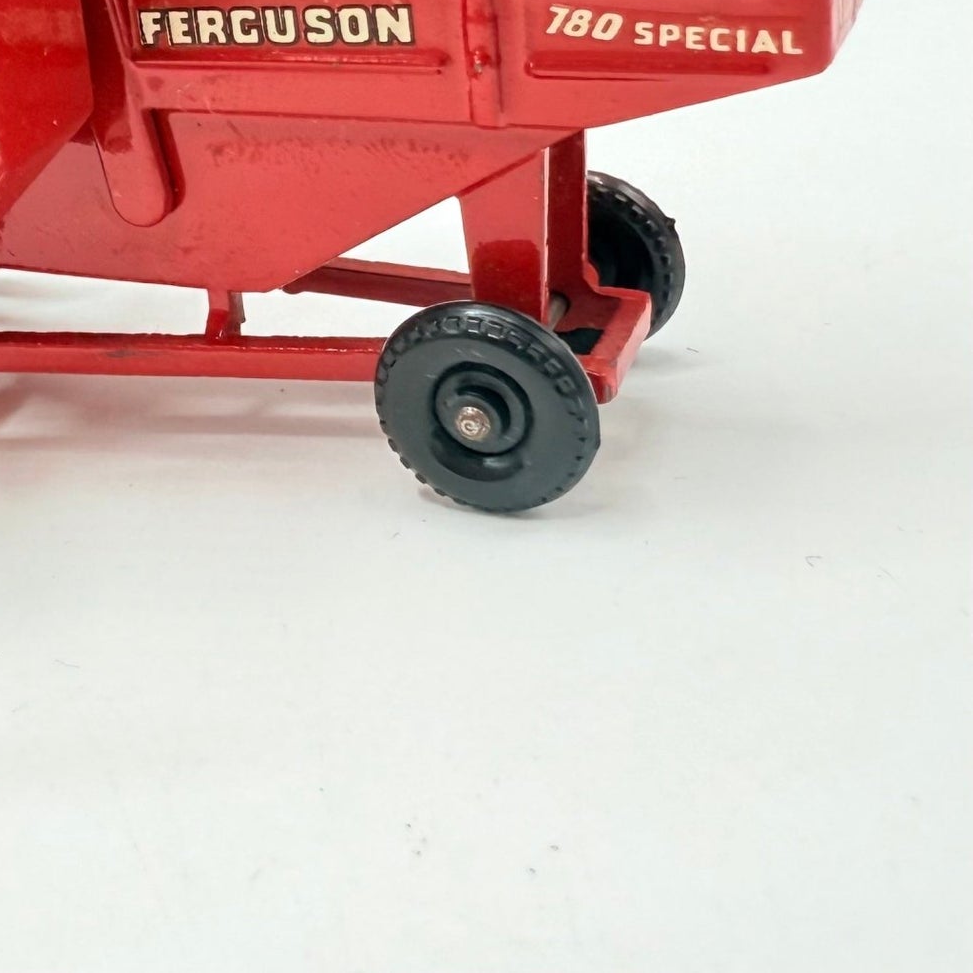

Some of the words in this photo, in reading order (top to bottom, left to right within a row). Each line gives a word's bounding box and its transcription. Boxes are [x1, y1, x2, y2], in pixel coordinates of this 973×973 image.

[137, 3, 416, 47] FERGUSON
[545, 5, 624, 41] 780
[633, 20, 804, 55] SPECIAL
